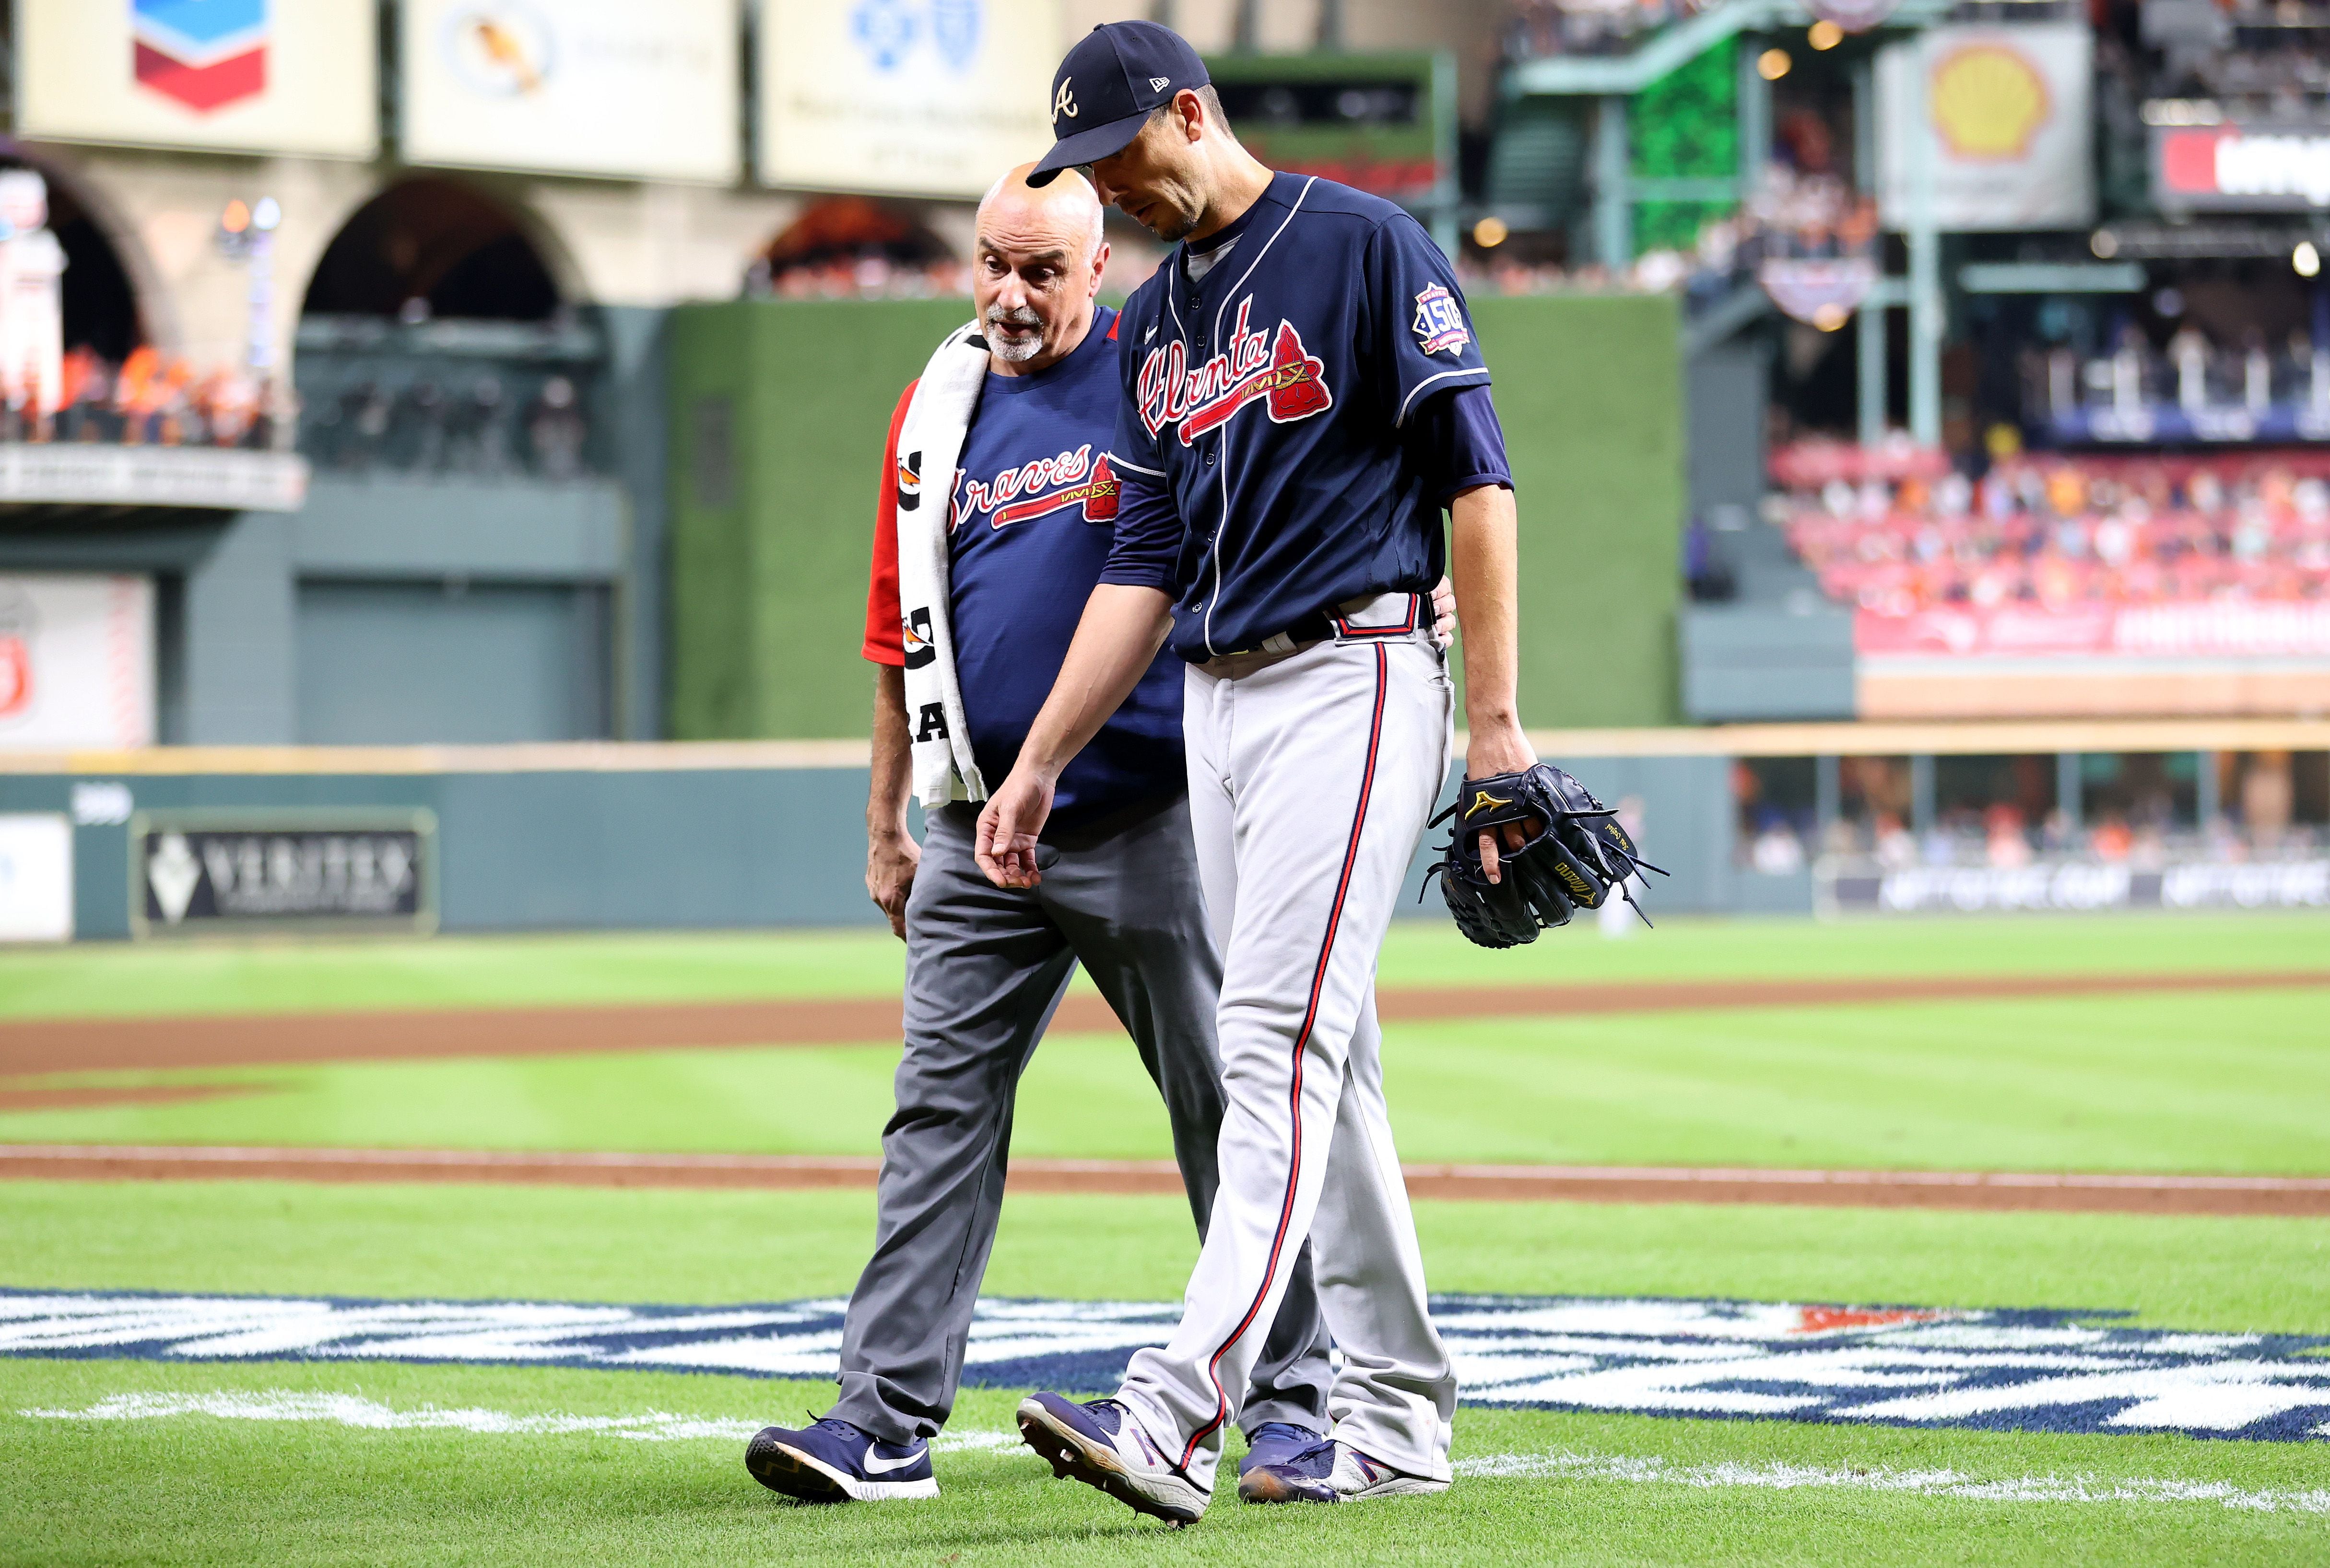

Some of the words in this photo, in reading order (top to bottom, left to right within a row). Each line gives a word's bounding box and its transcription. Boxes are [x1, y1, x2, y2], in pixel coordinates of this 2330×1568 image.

[1052, 77, 1078, 125] A
[1422, 291, 1447, 301] BRAVES
[1137, 293, 1270, 441] Atlanta
